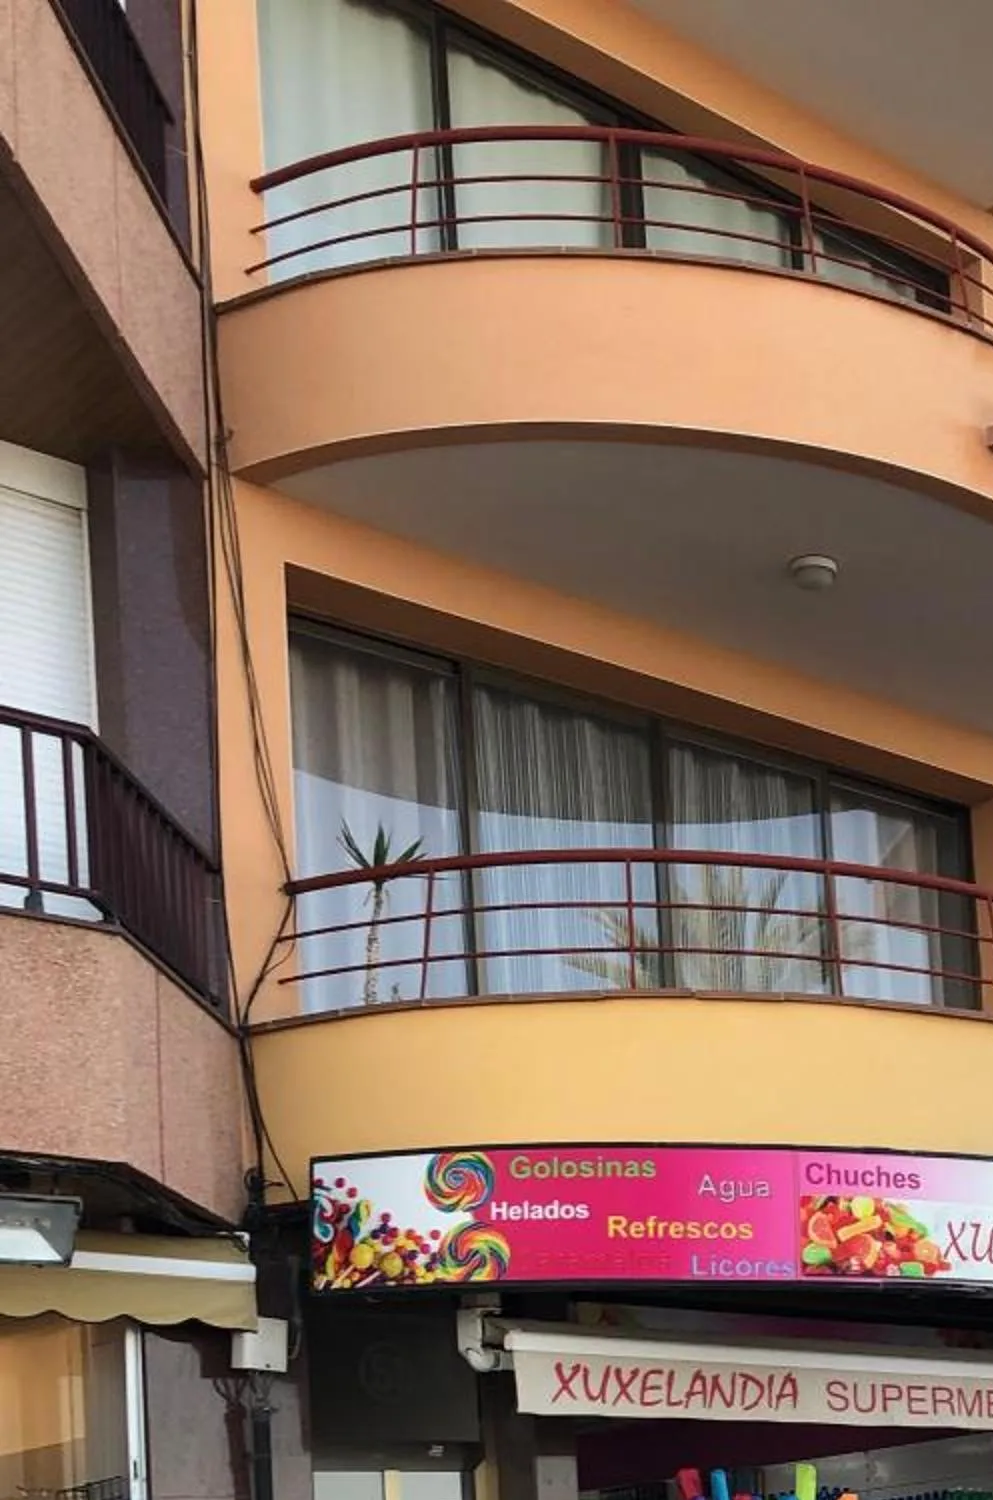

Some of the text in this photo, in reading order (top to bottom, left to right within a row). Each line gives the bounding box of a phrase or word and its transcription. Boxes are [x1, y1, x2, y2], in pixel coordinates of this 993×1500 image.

[509, 1155, 657, 1179] Golosinas
[804, 1161, 922, 1190] Chuches
[697, 1174, 770, 1202] Agua
[490, 1200, 590, 1221] Helados
[607, 1216, 754, 1240] Refrescos
[691, 1254, 794, 1277] Licores
[551, 1361, 799, 1411] XUXELANDIA
